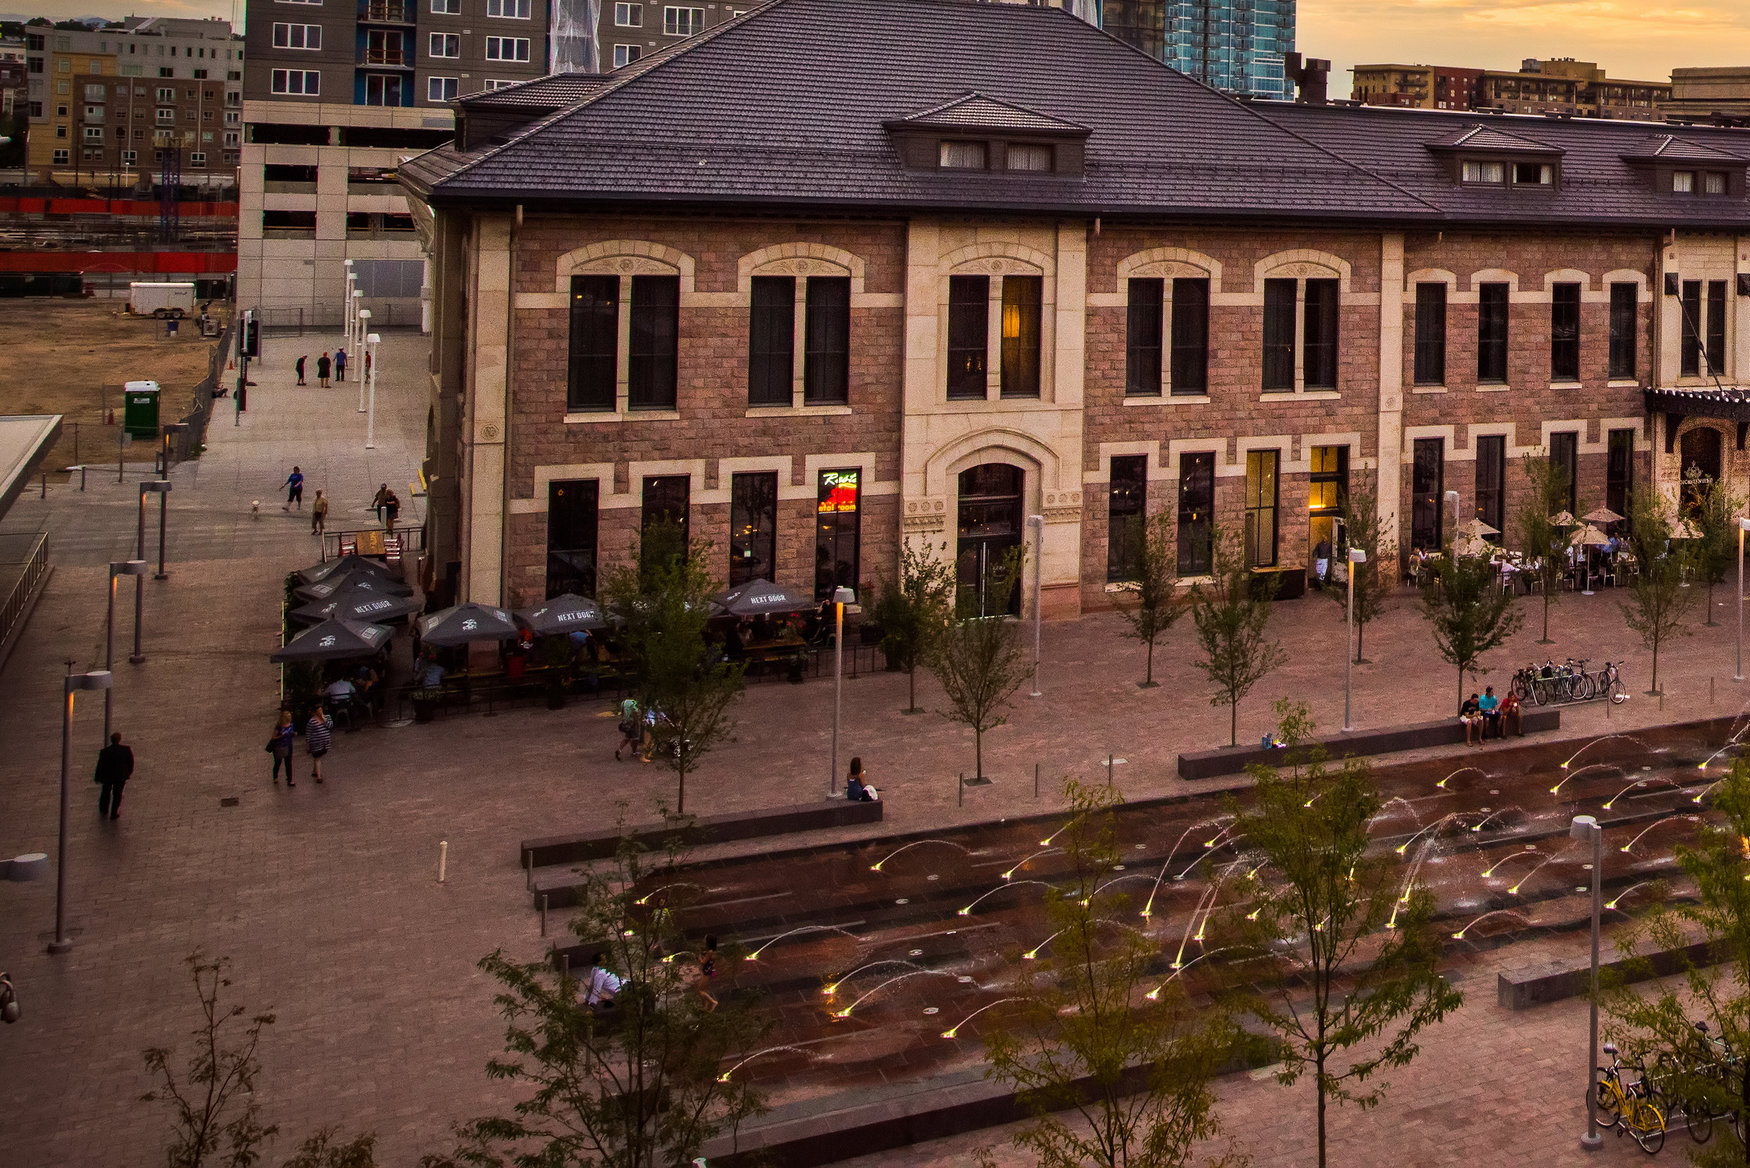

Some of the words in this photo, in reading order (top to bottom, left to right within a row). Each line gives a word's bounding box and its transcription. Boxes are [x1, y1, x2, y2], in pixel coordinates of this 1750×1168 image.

[750, 595, 767, 604] NEXT
[768, 594, 786, 602] DOOR
[354, 604, 373, 613] NEXT
[371, 600, 392, 610] DOOR
[557, 612, 576, 622] NEXT
